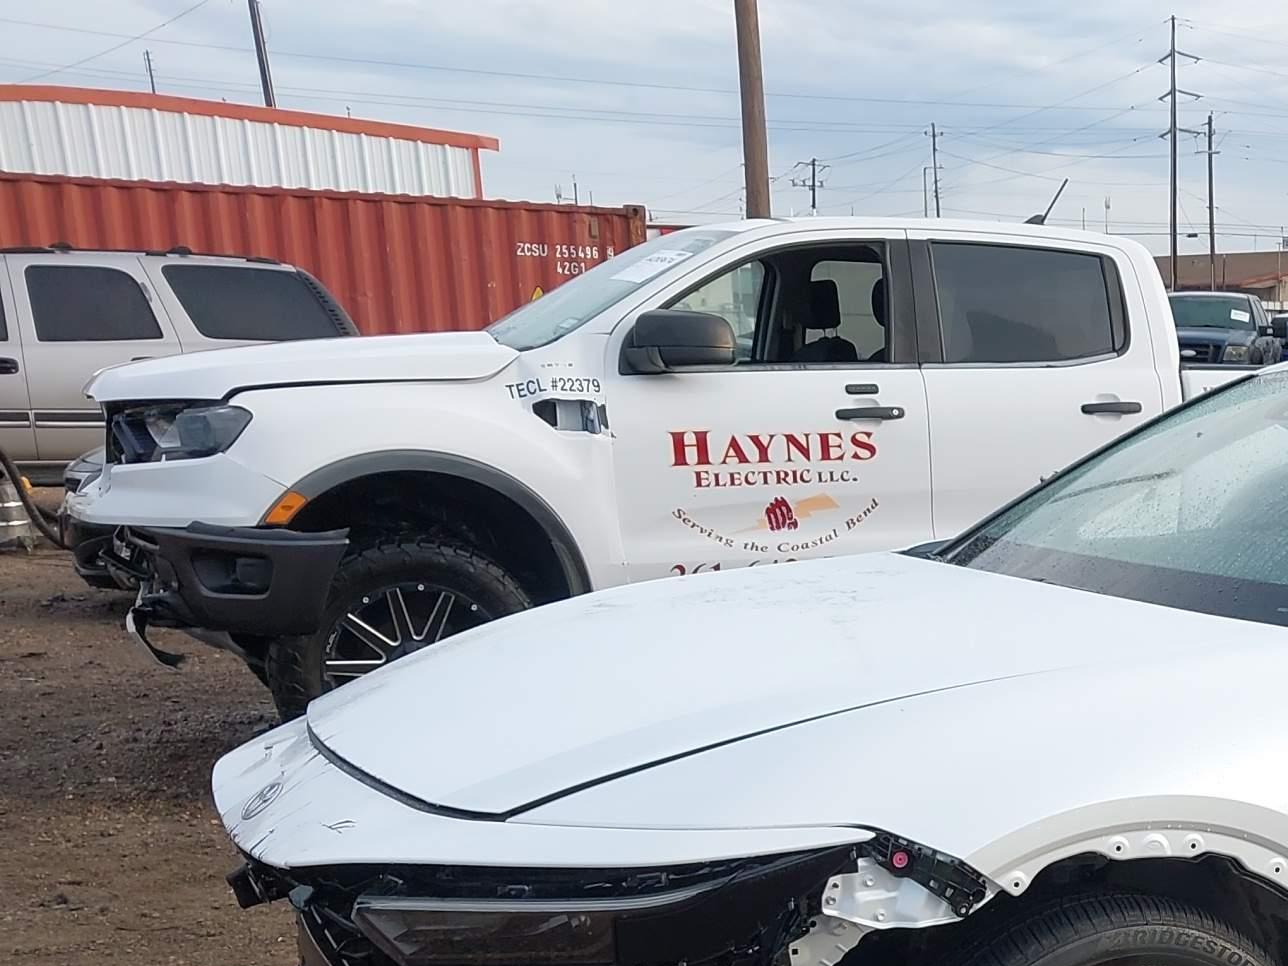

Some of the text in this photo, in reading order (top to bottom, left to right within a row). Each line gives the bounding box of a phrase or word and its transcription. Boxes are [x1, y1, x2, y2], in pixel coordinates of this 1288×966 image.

[516, 243, 548, 257] ZCSU
[555, 245, 599, 259] 255496
[556, 262, 586, 275] 42G1
[505, 377, 601, 399] TECL #22379
[668, 430, 877, 467] HAYNES
[694, 469, 813, 489] ELECTRIC
[671, 497, 880, 554] Serving the Coastal Bend
